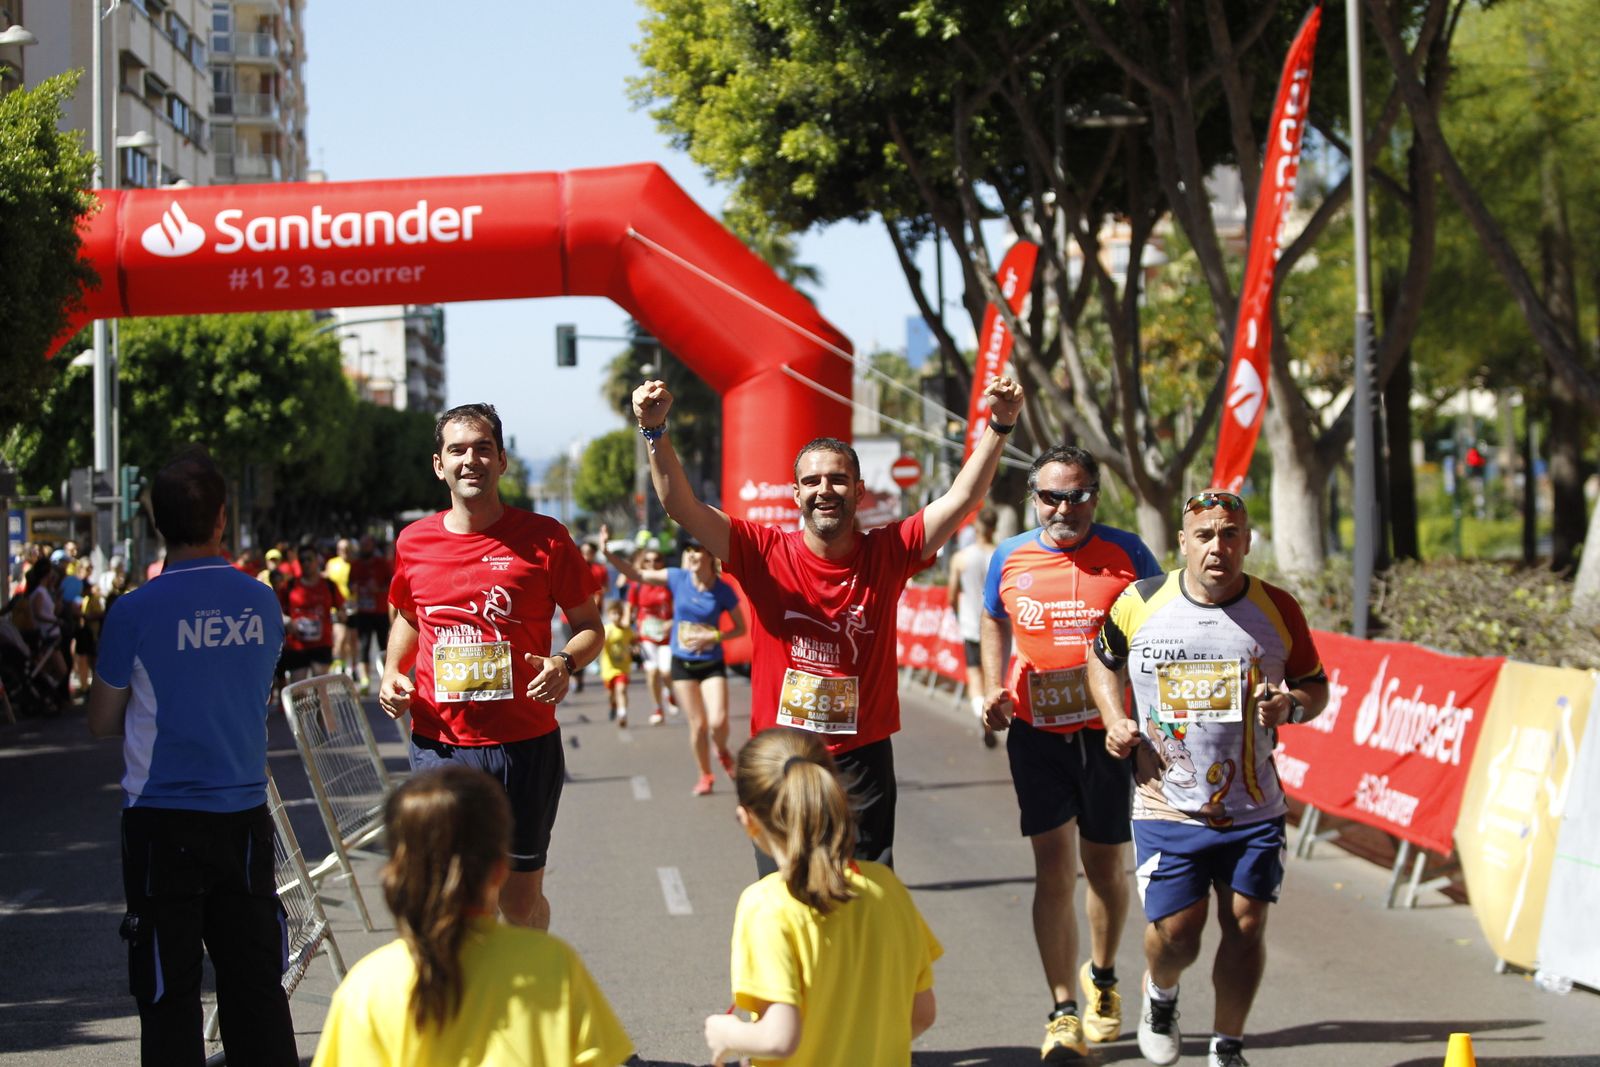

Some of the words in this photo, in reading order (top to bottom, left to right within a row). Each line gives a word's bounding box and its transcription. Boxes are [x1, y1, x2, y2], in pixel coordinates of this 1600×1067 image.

[214, 200, 482, 254] Santander
[195, 609, 221, 617] GRUPO
[1051, 600, 1086, 610] MEDIO
[1051, 608, 1104, 619] MARATÓN
[434, 624, 482, 636] CARRERA
[792, 635, 840, 654] CARRERA
[1142, 647, 1187, 660] CUNA
[791, 645, 840, 663] SOLIDARIA
[442, 661, 497, 681] 3310
[1035, 683, 1086, 706] 3311
[1167, 679, 1227, 699] 3286
[788, 689, 846, 712] 3285
